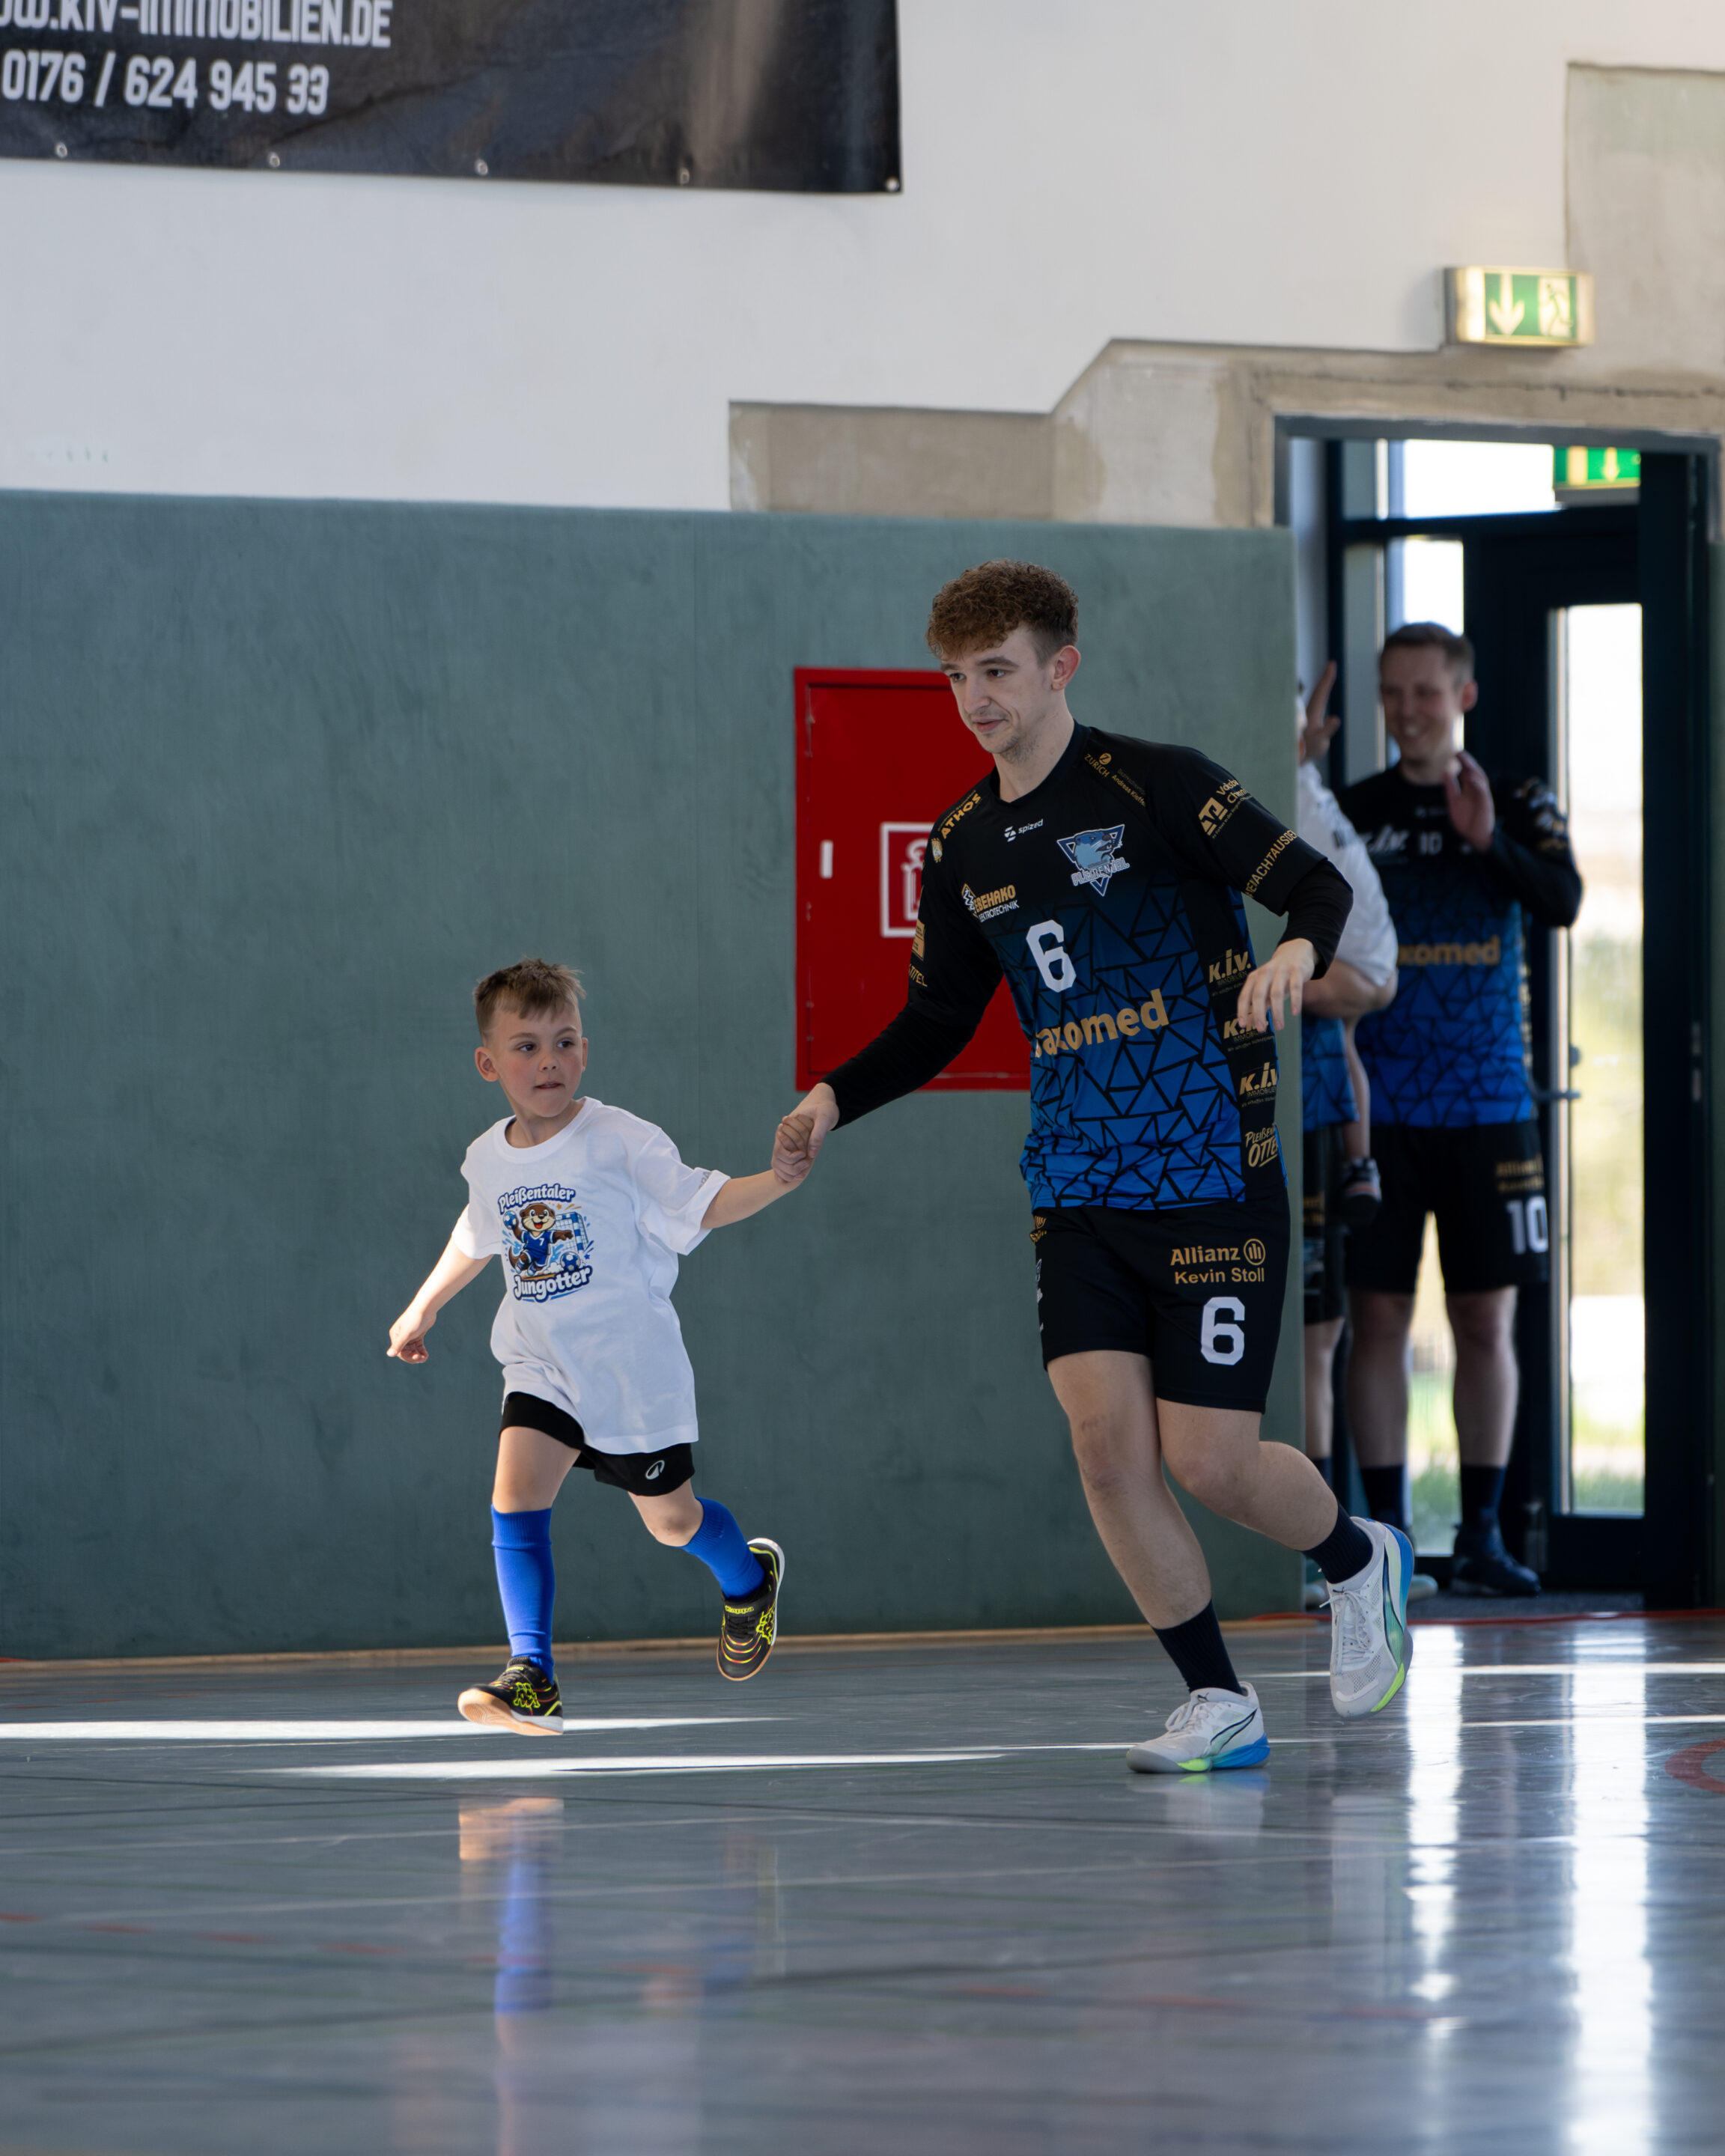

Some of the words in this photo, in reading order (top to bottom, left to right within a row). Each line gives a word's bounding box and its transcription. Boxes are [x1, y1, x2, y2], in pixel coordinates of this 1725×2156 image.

[2, 48, 86, 103] 0176
[94, 50, 116, 107] /
[124, 55, 197, 109] 624
[210, 58, 277, 112] 945
[287, 63, 329, 115] 33
[1084, 753, 1110, 777] ZURICH
[941, 793, 982, 839] ATHOS
[1018, 819, 1044, 834] spized
[1026, 920, 1077, 993] 6
[499, 1184, 575, 1214] Pleißentaler
[1506, 1196, 1548, 1255] 10
[1170, 1246, 1241, 1266] Allianz
[514, 1266, 592, 1301] Jungotter
[1175, 1269, 1226, 1285] Kevin
[1232, 1267, 1265, 1282] Stoll
[1201, 1297, 1245, 1366] 6
